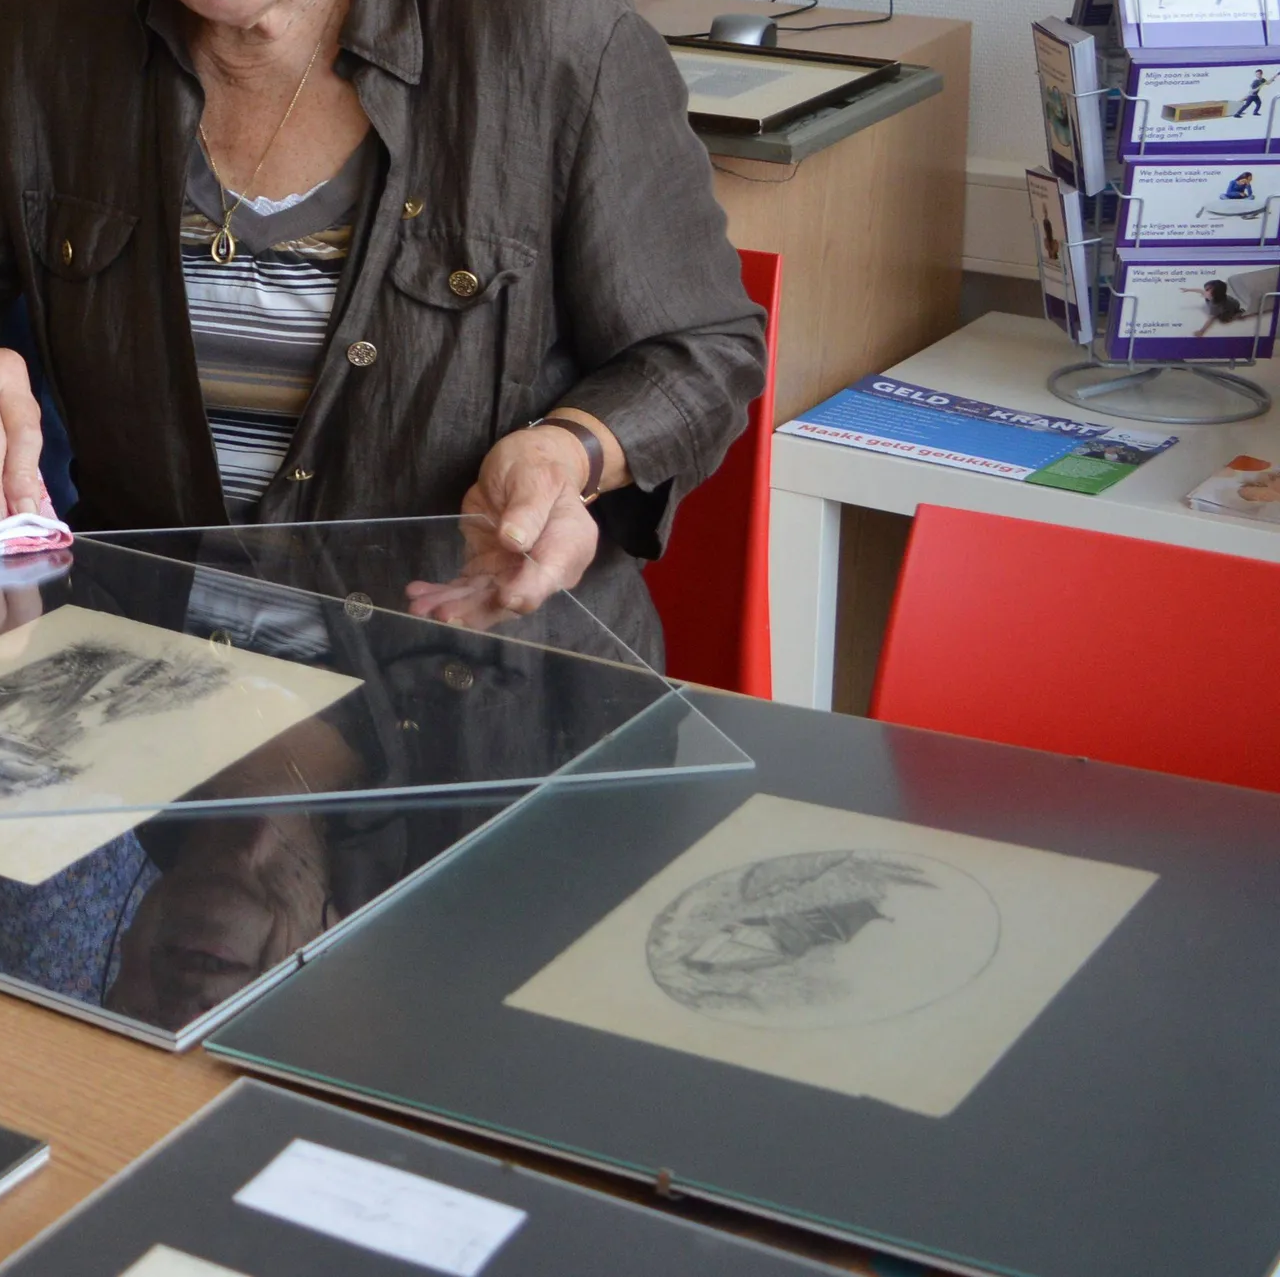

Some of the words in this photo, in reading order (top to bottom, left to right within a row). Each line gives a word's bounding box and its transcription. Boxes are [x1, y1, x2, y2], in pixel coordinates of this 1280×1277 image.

[1156, 125, 1166, 133] ga
[1138, 132, 1165, 140] gdrag
[1131, 229, 1165, 237] psitieve
[872, 381, 950, 405] GELD
[988, 409, 1095, 436] KRANT
[797, 424, 865, 442] Maakt
[866, 437, 916, 452] geld
[918, 447, 1027, 474] gelukkig?
